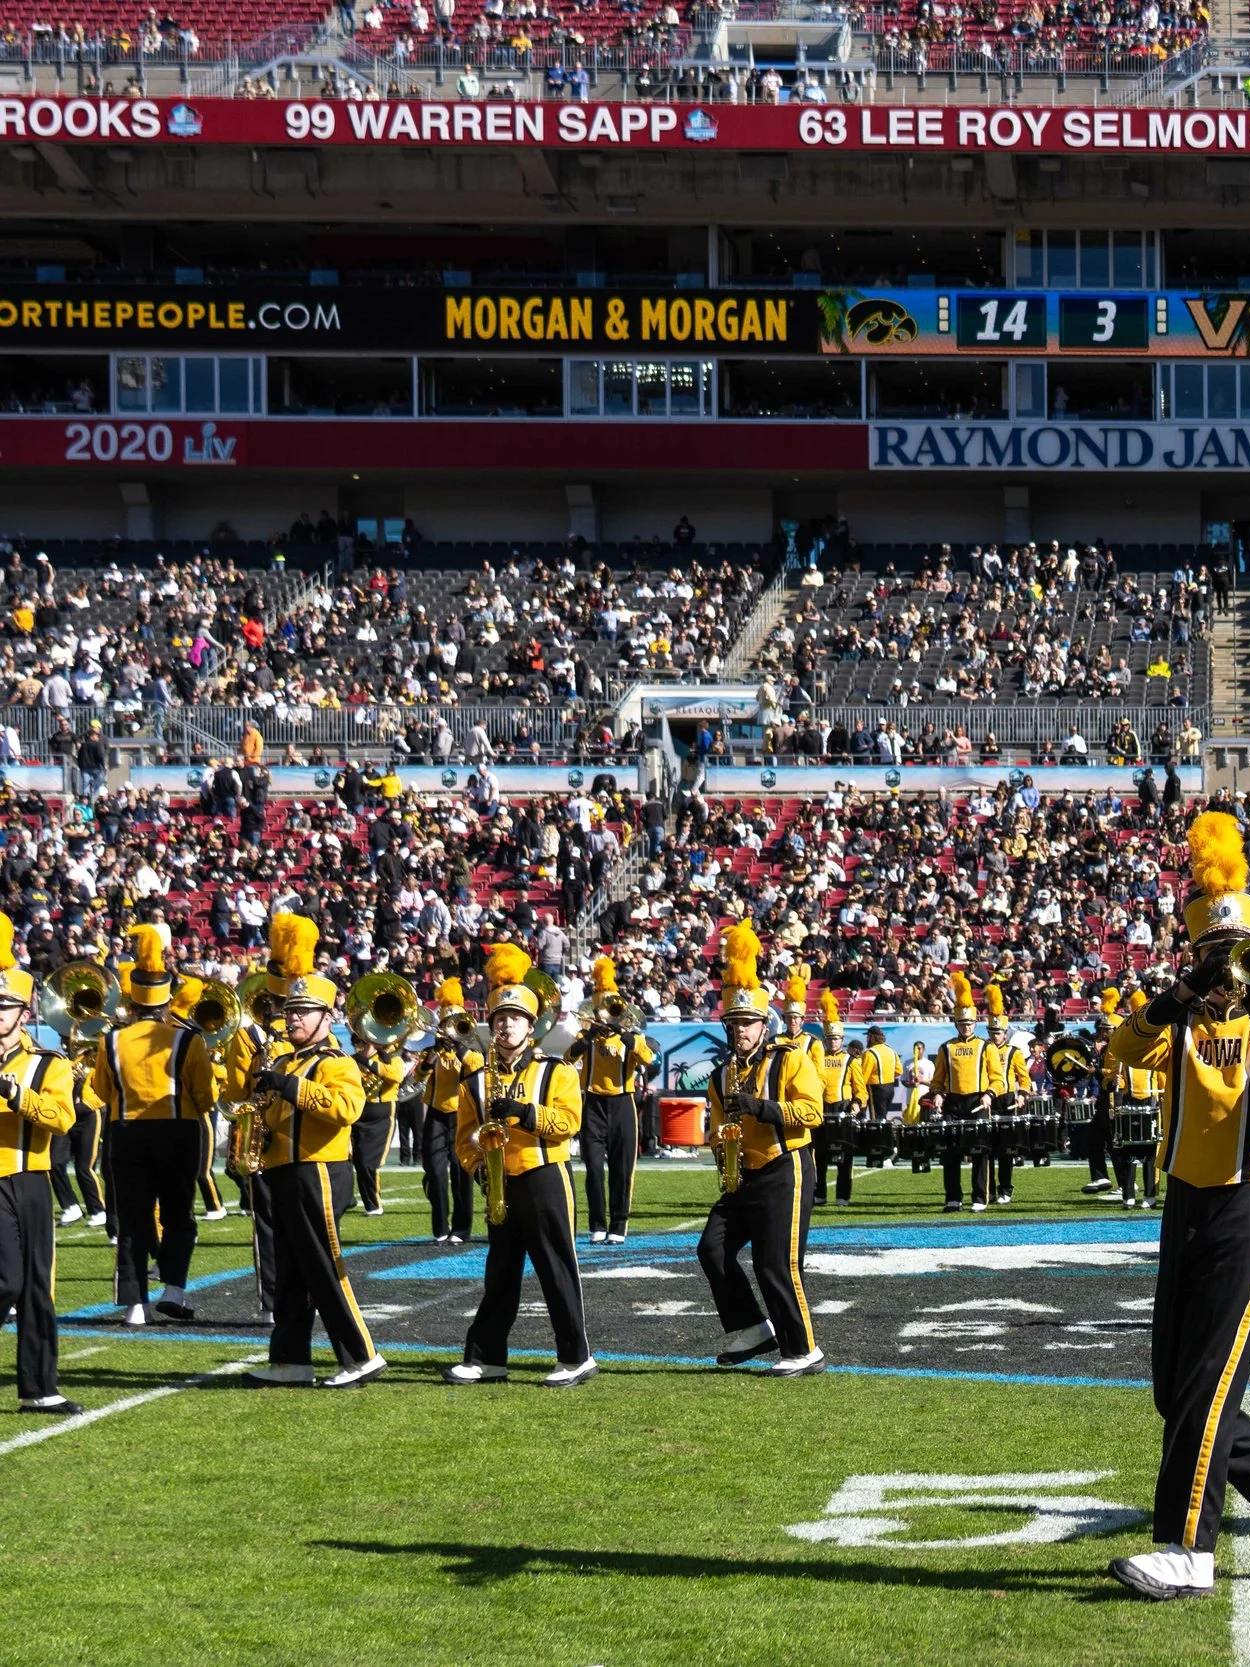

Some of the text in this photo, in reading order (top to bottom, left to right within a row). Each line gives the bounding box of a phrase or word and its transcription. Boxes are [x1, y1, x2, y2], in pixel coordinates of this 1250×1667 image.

[0, 99, 161, 138] ROOKS
[286, 103, 678, 142] 99 WARREN SAPP
[799, 108, 1246, 149] 63 LEE ROY SELMON
[445, 297, 788, 342] MORGAN & MORGAN
[976, 300, 1028, 341] 14
[1092, 301, 1117, 342] 3
[65, 423, 173, 461] 2020
[874, 427, 1154, 468] RAYMOND
[824, 1058, 842, 1069] IOWA
[954, 1046, 974, 1057] IOWA
[1195, 1037, 1243, 1068] IOWA
